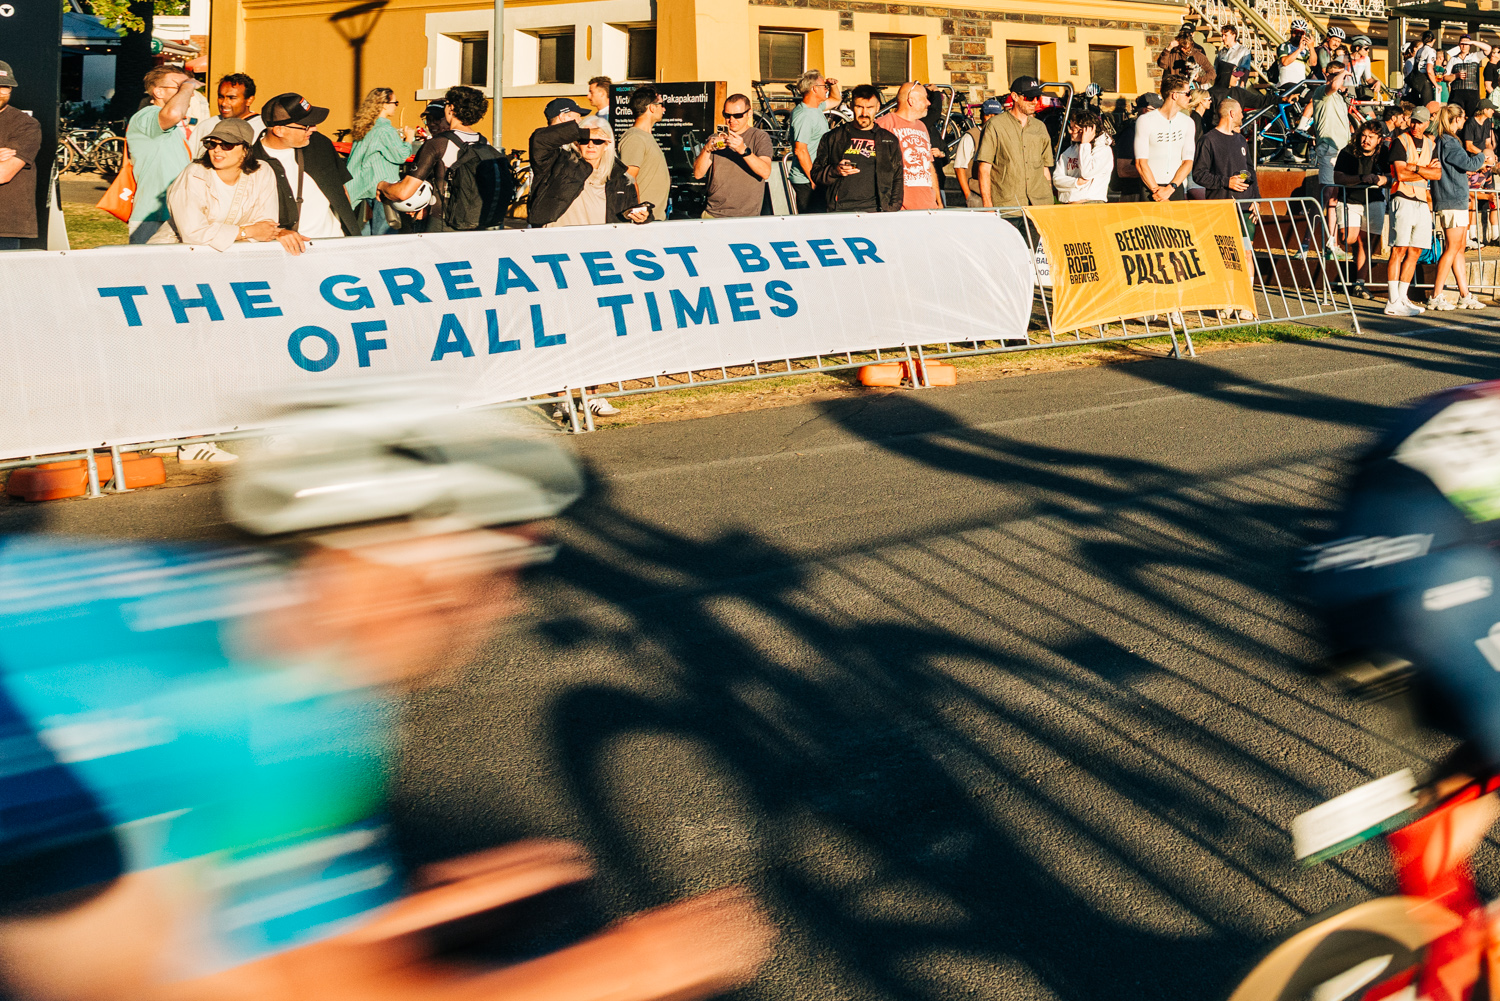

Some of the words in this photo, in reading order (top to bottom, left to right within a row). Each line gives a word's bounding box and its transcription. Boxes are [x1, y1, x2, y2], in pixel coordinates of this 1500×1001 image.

[662, 93, 709, 105] Pakapakanthi
[1063, 241, 1093, 256] BRIDGE
[1114, 224, 1195, 252] BEECHWORTH
[1214, 234, 1236, 248] BRIDGE
[1121, 250, 1174, 286] PALE
[1169, 248, 1206, 283] ALE
[98, 281, 283, 326] THE
[320, 246, 698, 310] GREATEST
[729, 237, 884, 273] BEER
[1070, 271, 1100, 285] BREWERS
[288, 320, 387, 372] OF
[431, 304, 566, 361] ALL
[597, 280, 798, 337] TIMES
